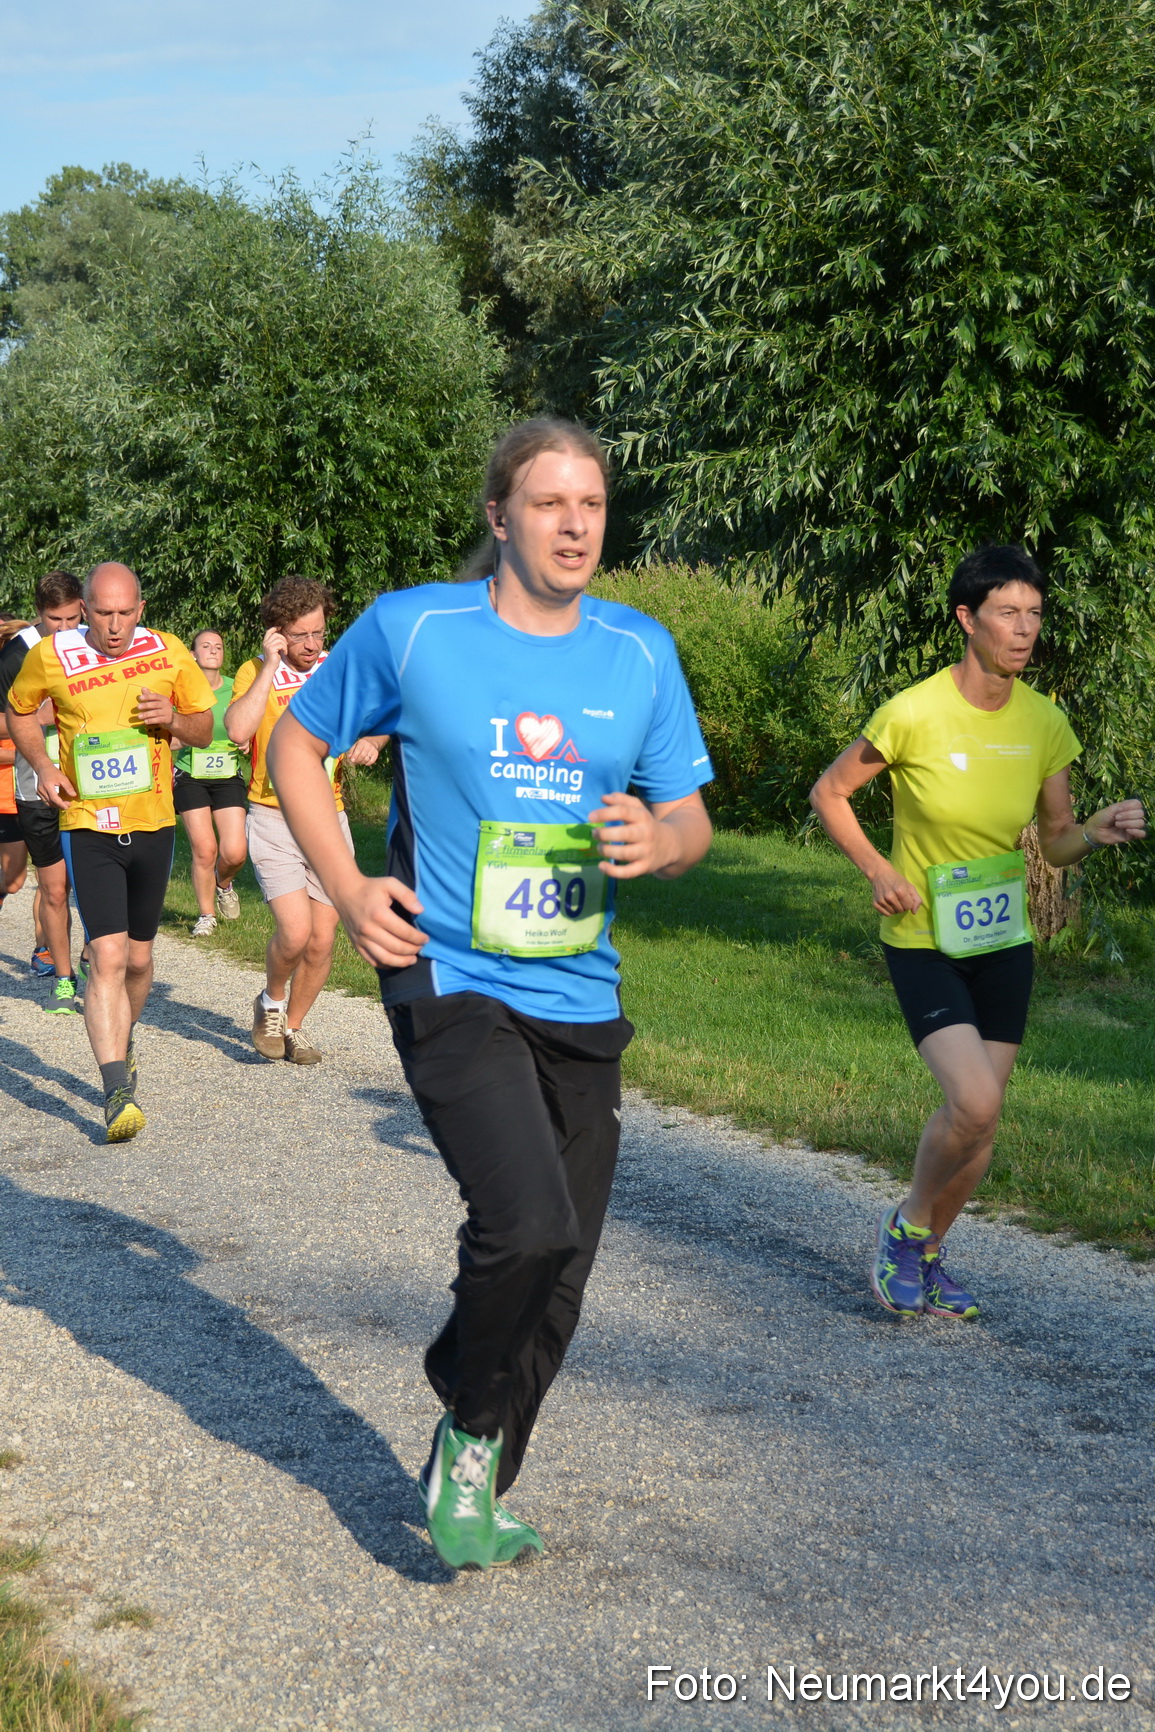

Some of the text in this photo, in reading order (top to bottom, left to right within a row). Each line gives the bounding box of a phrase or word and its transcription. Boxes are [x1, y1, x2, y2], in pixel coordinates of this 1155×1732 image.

[68, 656, 173, 697] MAX BÖGL
[490, 718, 509, 757] I
[91, 754, 138, 781] 884
[205, 756, 224, 768] 25
[114, 780, 135, 788] Gerhardt
[490, 761, 584, 791] camping
[548, 789, 582, 805] Berger
[502, 846, 554, 856] firmenlauf
[505, 877, 586, 920] 480
[955, 893, 1010, 931] 632
[525, 928, 568, 937] Heiko Wolf
[973, 932, 994, 942] Brigitte
